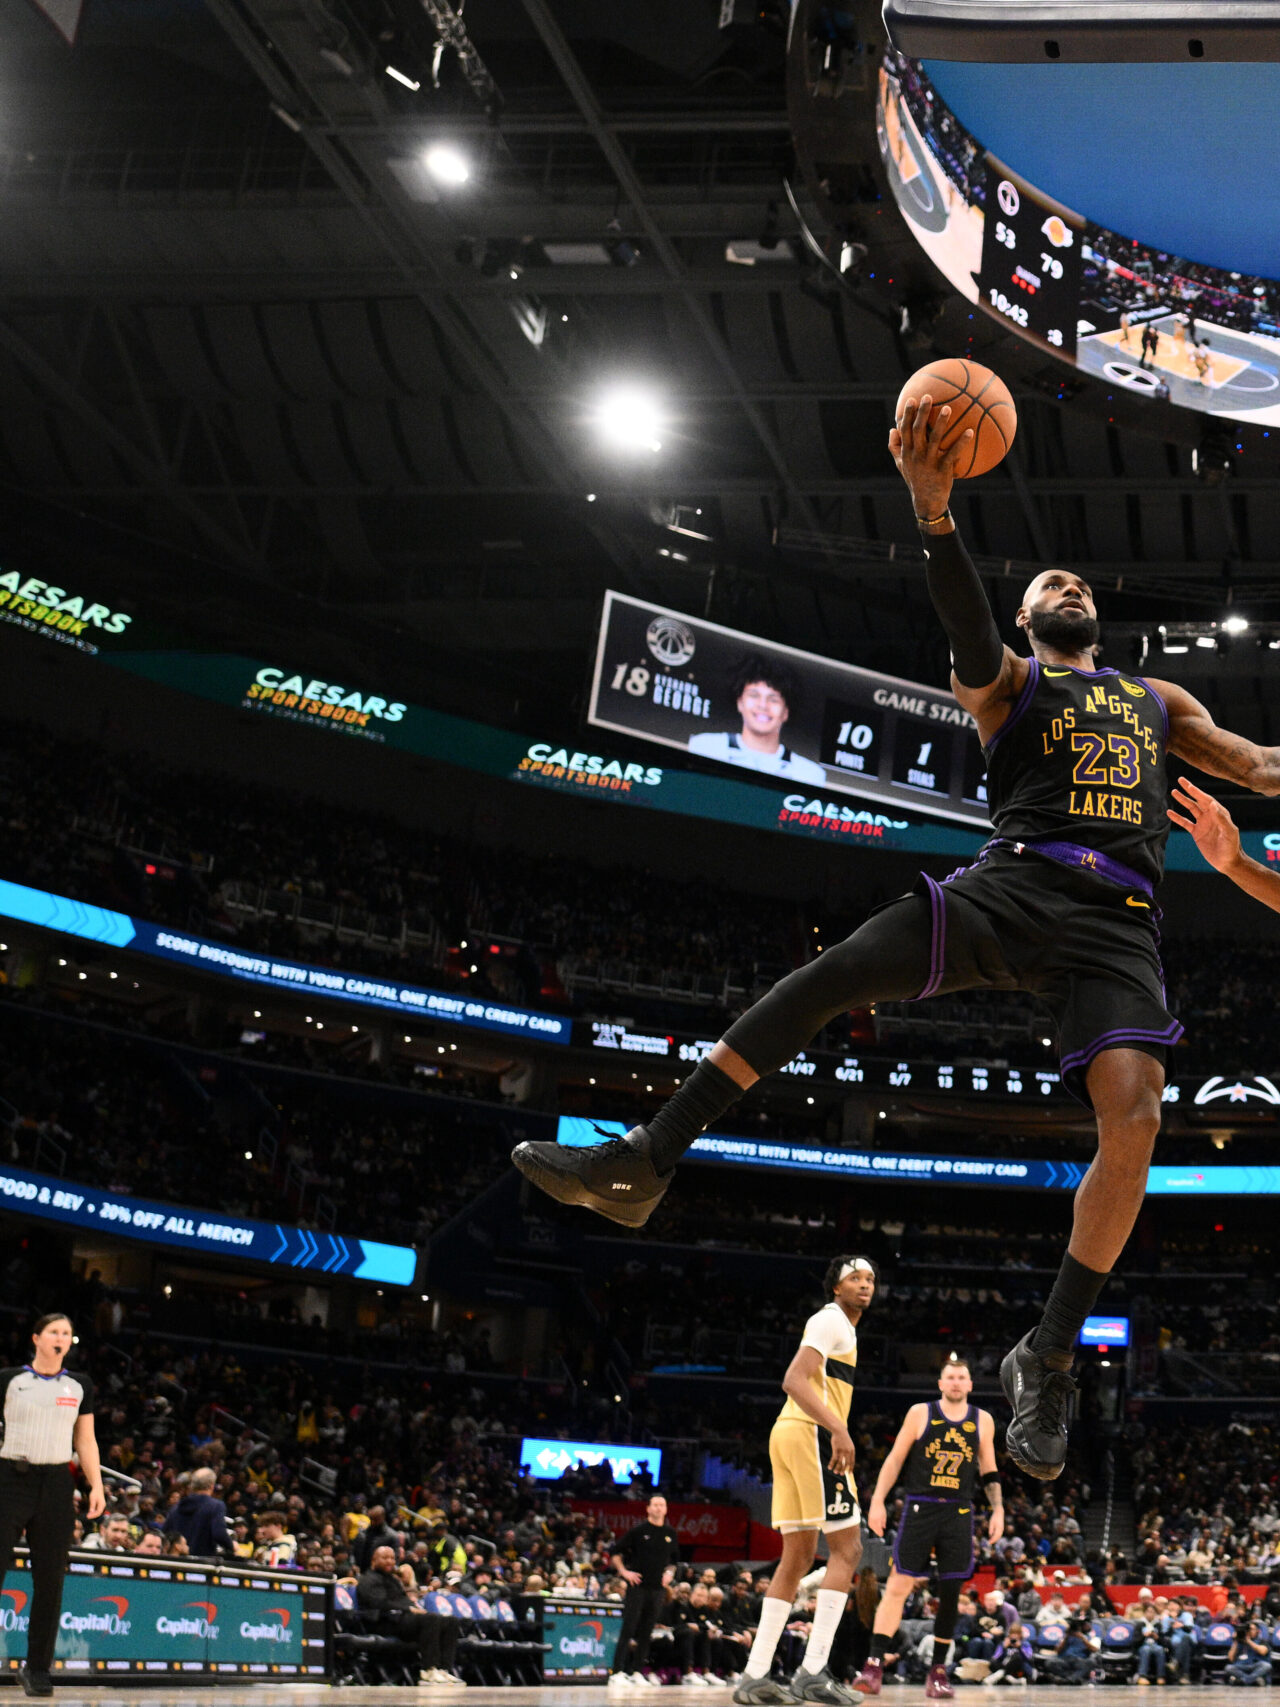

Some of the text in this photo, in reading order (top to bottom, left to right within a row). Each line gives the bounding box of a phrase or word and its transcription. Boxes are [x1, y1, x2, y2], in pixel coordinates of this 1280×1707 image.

[995, 221, 1016, 249] 53
[1040, 252, 1063, 279] 79
[989, 288, 1028, 327] 10:42
[0, 570, 132, 633] AESARS
[256, 668, 407, 722] CAESARS
[611, 663, 650, 696] 18
[247, 683, 371, 727] SPORTSBOOK
[653, 685, 711, 718] GEORGE
[873, 688, 927, 716] GAME
[837, 721, 873, 750] 10
[1042, 686, 1158, 766] LOS ANGELES
[528, 743, 663, 785] CAESARS
[917, 742, 932, 766] 1
[1071, 733, 1141, 789] 23
[518, 758, 633, 792] SPORTSBOOK
[778, 809, 884, 837] SPORTSBOOK
[1068, 791, 1142, 825] LAKERS
[1081, 852, 1097, 869] LAL
[156, 932, 562, 1033] SCORE DISCOUNTS WITH YOUR CAPITAL ONE DEBIT OR CREDIT CARD
[835, 1067, 864, 1082] 6/21
[758, 1145, 790, 1159] WITH
[791, 1148, 823, 1163] YOUR
[823, 1152, 870, 1168] CAPITAL
[872, 1157, 898, 1170] ONE
[898, 1158, 934, 1171] DEBIT
[934, 1160, 953, 1173] OR
[953, 1161, 994, 1175] CREDIT
[995, 1164, 1028, 1177] CARD
[38, 1187, 50, 1204] &
[52, 1190, 84, 1211] BEV
[99, 1202, 131, 1223] 20%
[132, 1210, 165, 1229] OFF
[164, 1216, 195, 1236] ALL
[197, 1222, 254, 1245] MERCH
[925, 1438, 941, 1458] LOS
[933, 1449, 964, 1475] 77
[930, 1474, 960, 1489] LAKERS
[827, 1491, 850, 1515] dc
